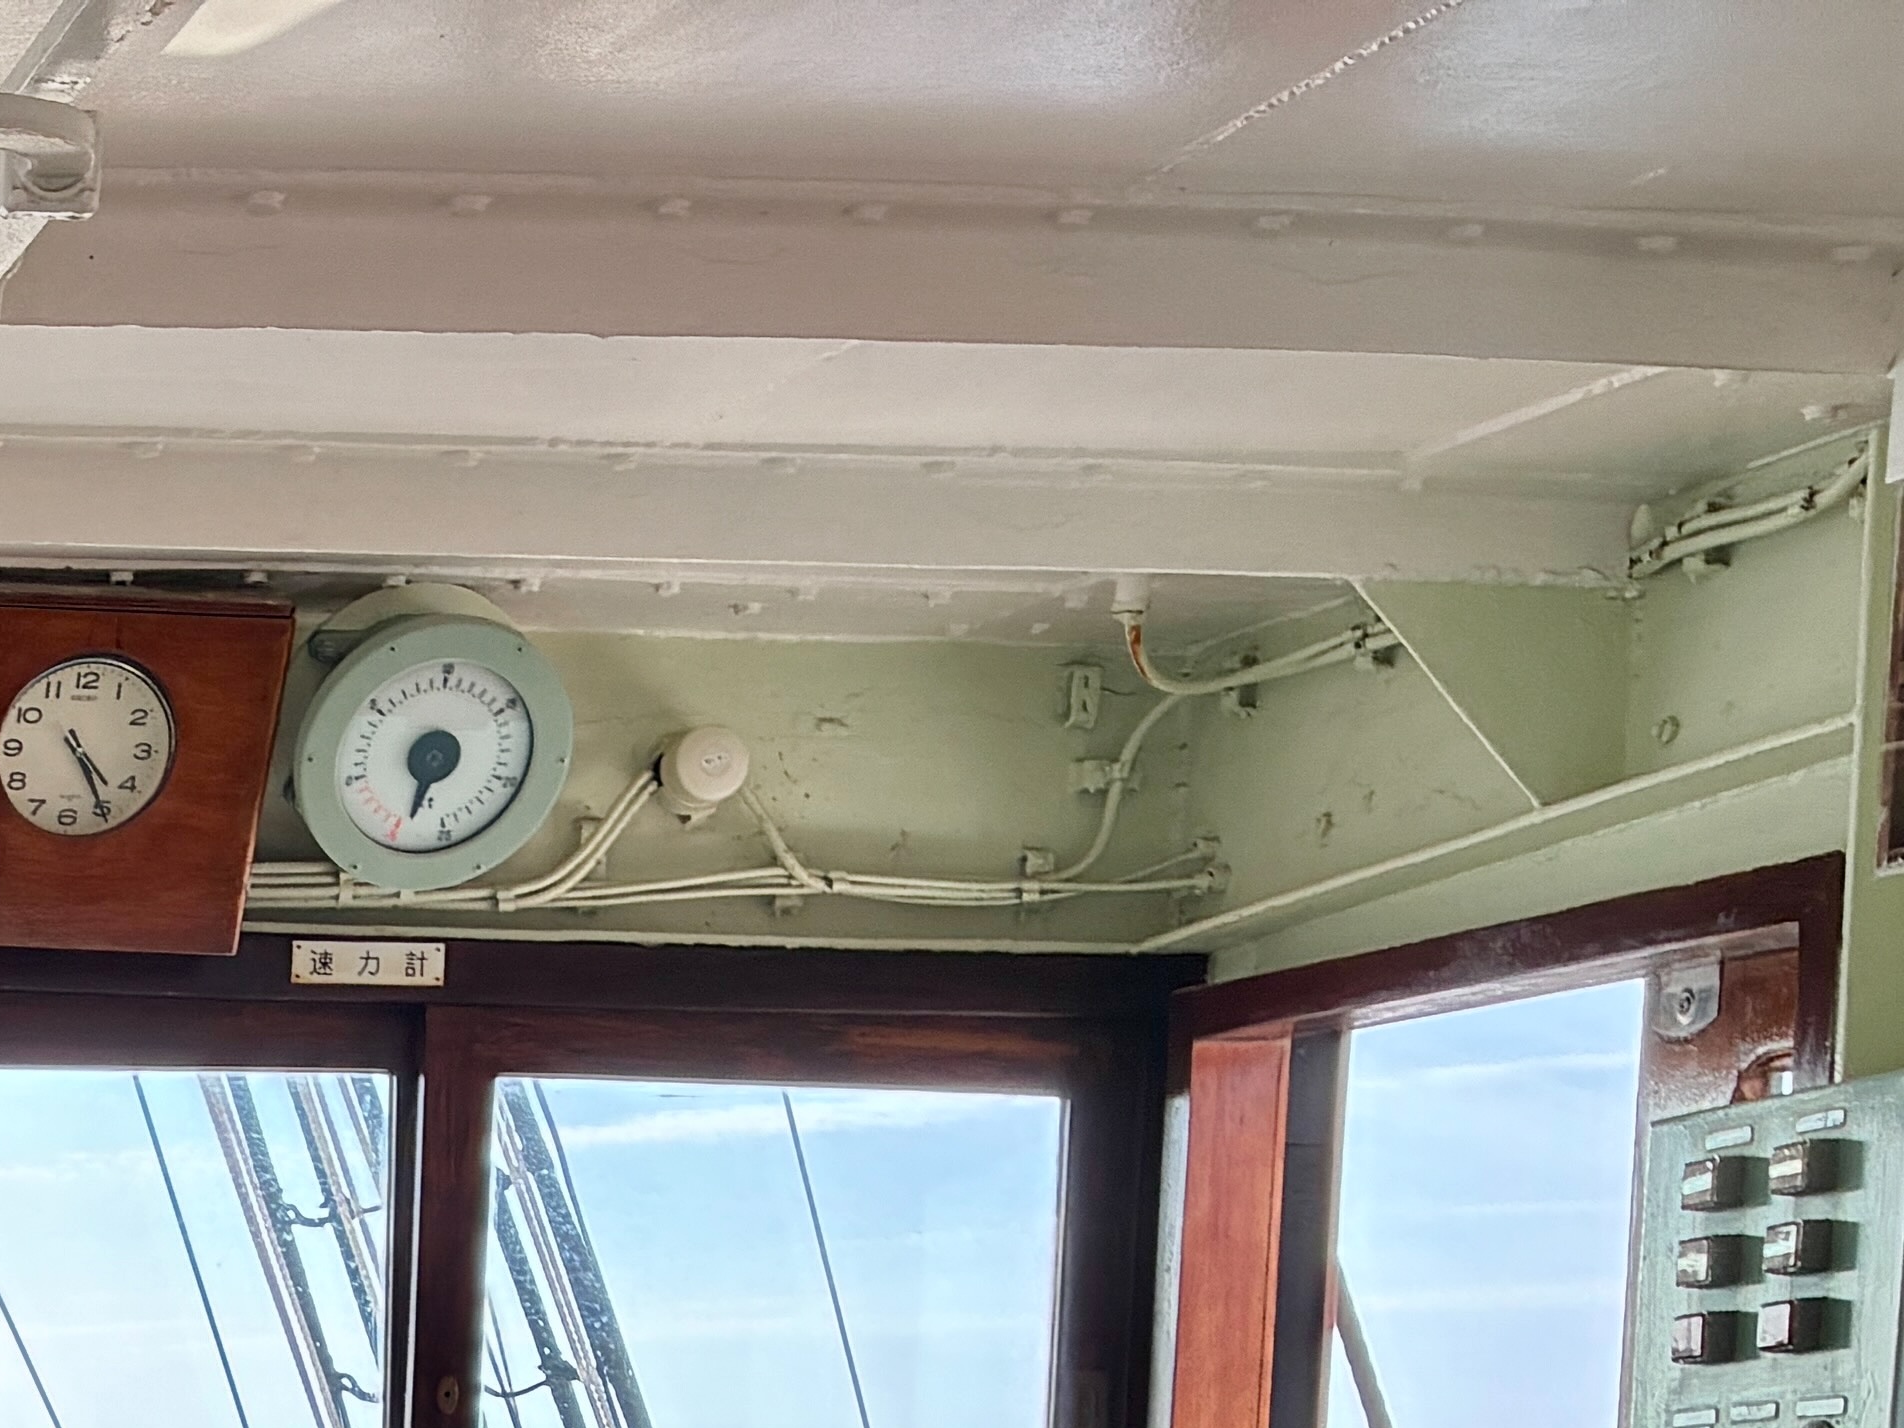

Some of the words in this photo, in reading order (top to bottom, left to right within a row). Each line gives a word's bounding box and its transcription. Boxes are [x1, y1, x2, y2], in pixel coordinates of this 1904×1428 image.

[75, 672, 100, 689] 12
[45, 681, 62, 699] 11
[116, 682, 122, 700] 1
[17, 707, 43, 723] 10
[129, 708, 149, 726] 2
[3, 738, 23, 757] 9
[133, 743, 152, 760] 3
[7, 772, 26, 790] 8
[117, 775, 137, 793] 4
[27, 798, 46, 816] 7
[57, 808, 78, 826] 6
[309, 949, 428, 978] 速力計
